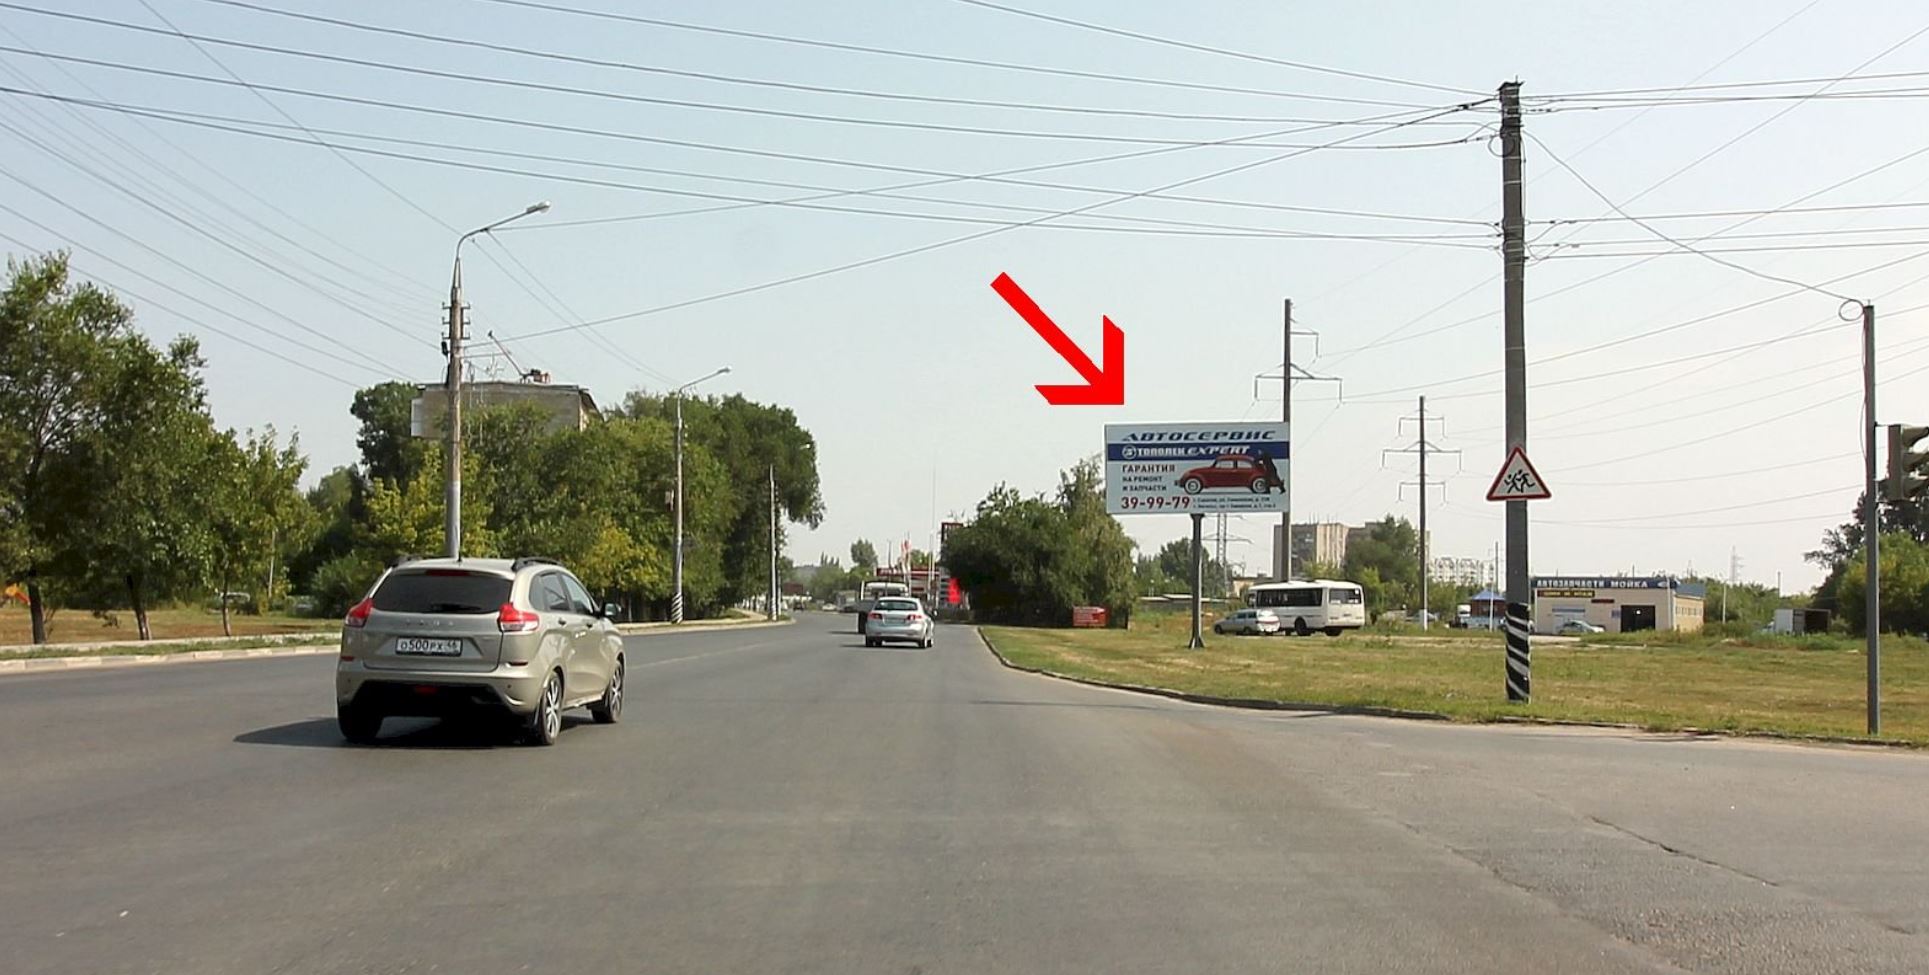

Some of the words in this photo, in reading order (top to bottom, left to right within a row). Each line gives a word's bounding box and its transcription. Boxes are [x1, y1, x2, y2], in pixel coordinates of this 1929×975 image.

[1122, 430, 1276, 442] АВТОСЕРВИС
[1122, 464, 1175, 473] ГАРАНТИЯ
[1133, 475, 1162, 483] РЕМОНТ
[1129, 484, 1167, 492] ЗАПЧАСТИ
[1121, 496, 1190, 510] 39-99-79
[1536, 579, 1604, 588] АВТОЗАПЧАСТИ
[1611, 580, 1649, 588] МОЙКА
